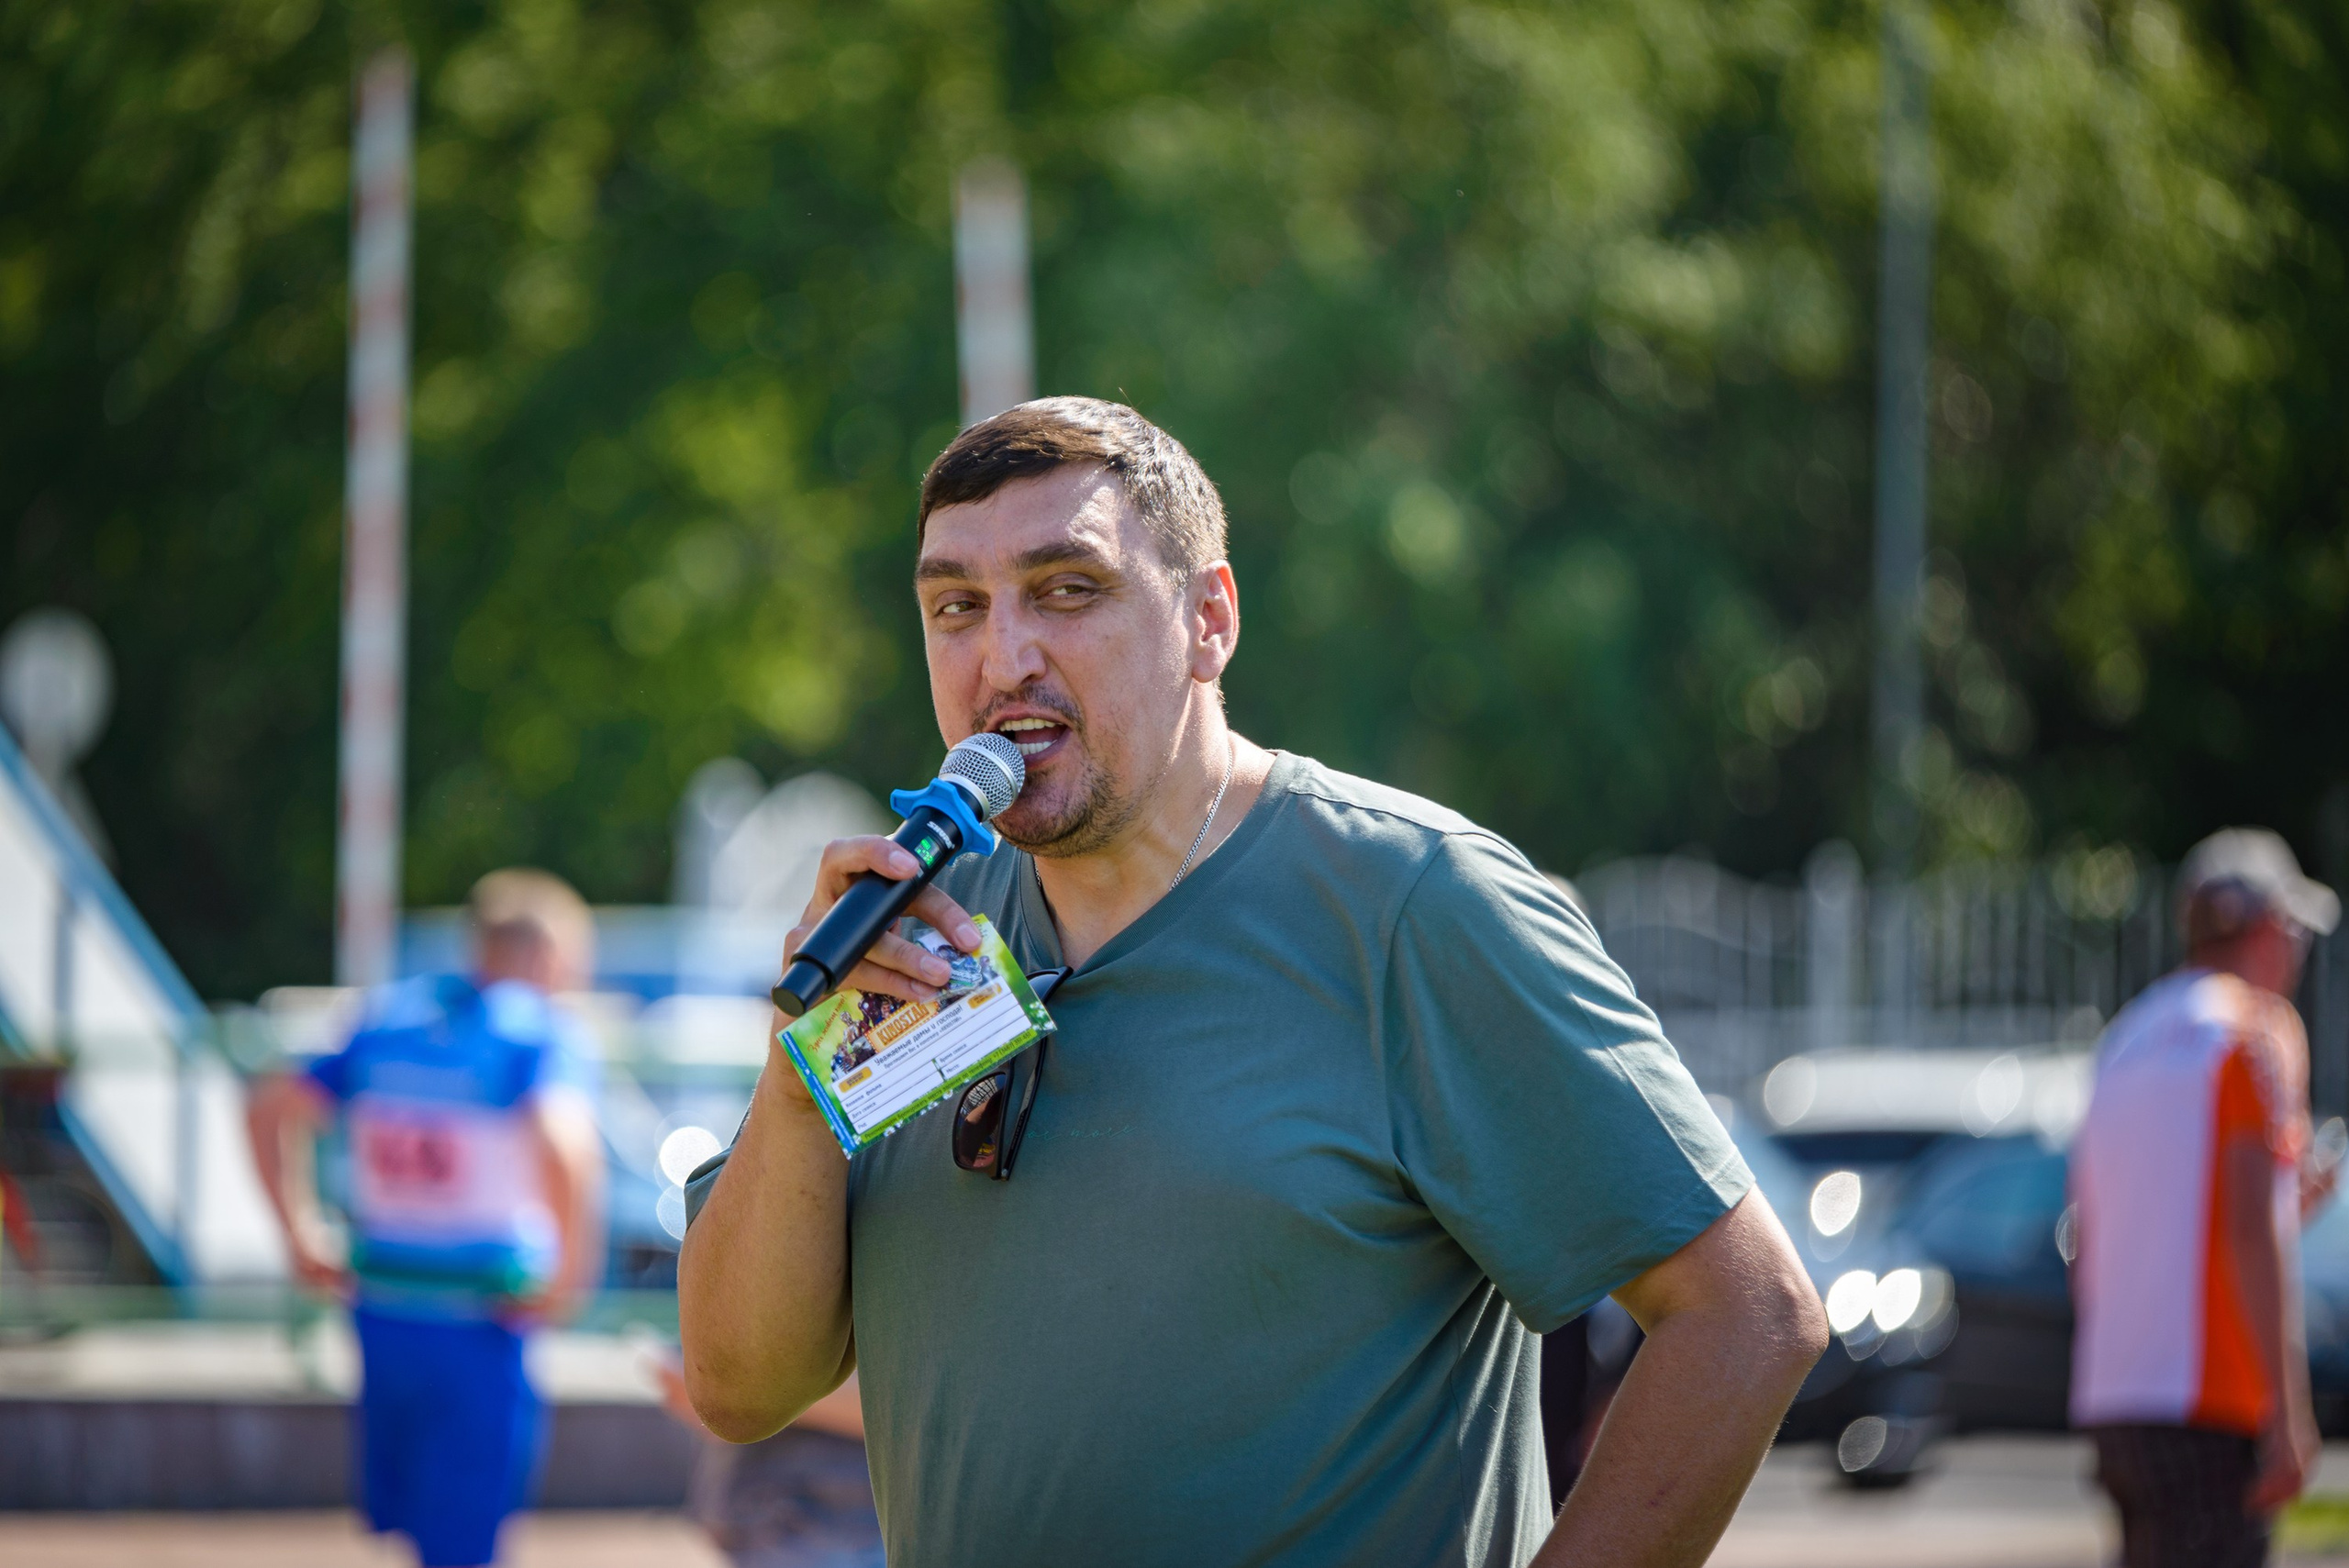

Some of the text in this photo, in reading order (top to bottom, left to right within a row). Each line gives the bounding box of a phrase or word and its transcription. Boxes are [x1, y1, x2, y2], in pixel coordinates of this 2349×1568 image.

[874, 1038, 912, 1065] Уважаемые
[911, 1026, 931, 1042] дамы
[935, 1004, 963, 1027] господа!
[875, 1003, 930, 1046] KINOSTAR
